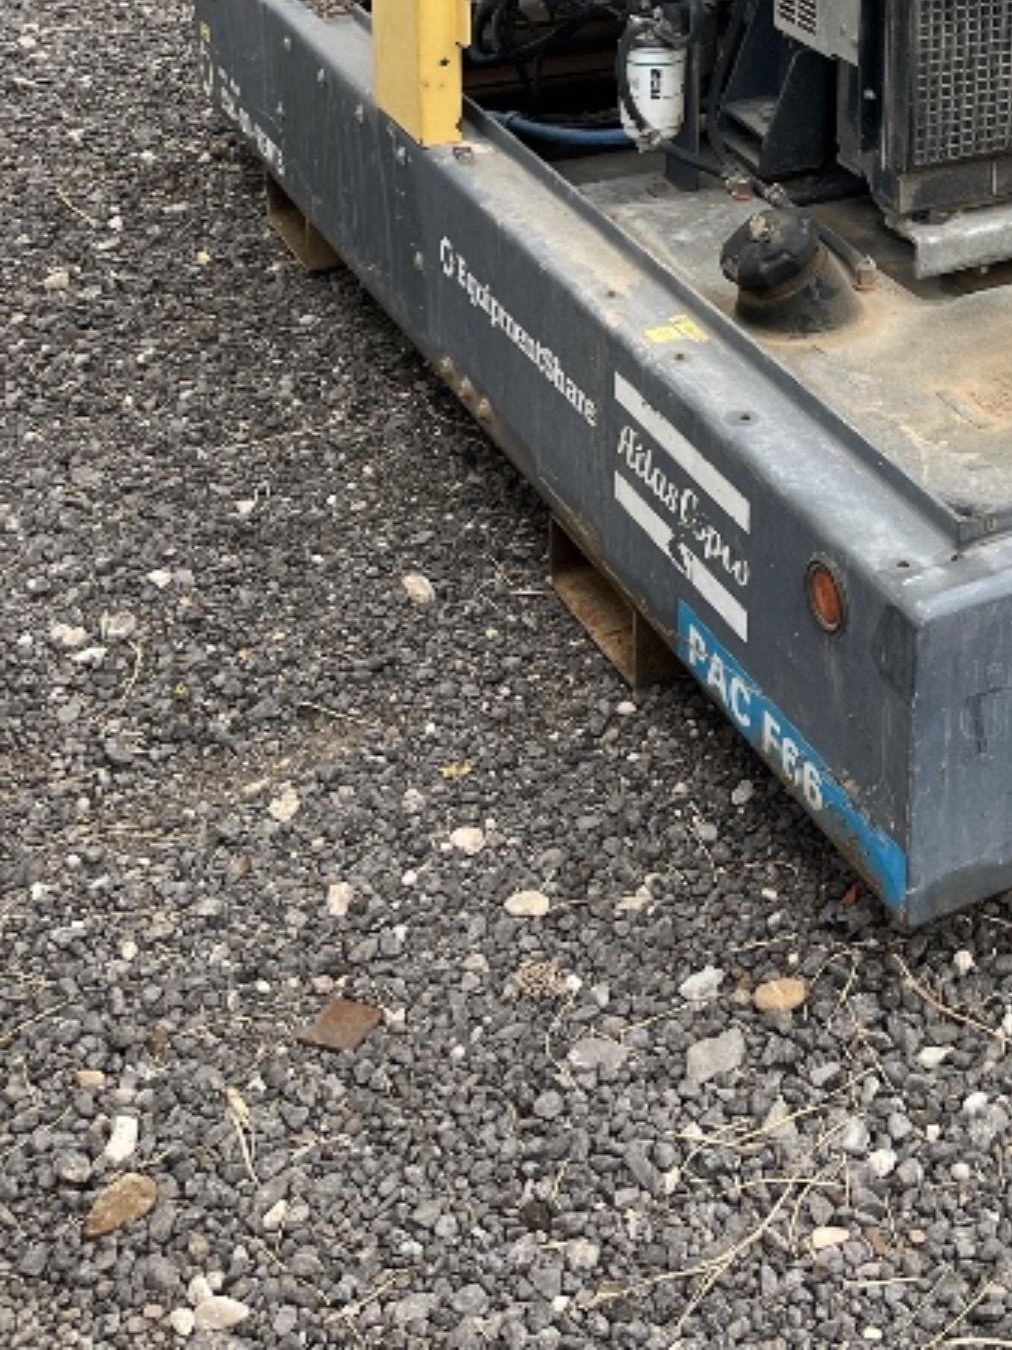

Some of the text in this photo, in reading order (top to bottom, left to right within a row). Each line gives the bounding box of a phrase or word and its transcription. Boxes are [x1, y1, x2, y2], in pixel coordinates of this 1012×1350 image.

[457, 253, 597, 427] EquipmentShare
[617, 425, 678, 514] Atlas
[689, 623, 823, 811] PAC F66
